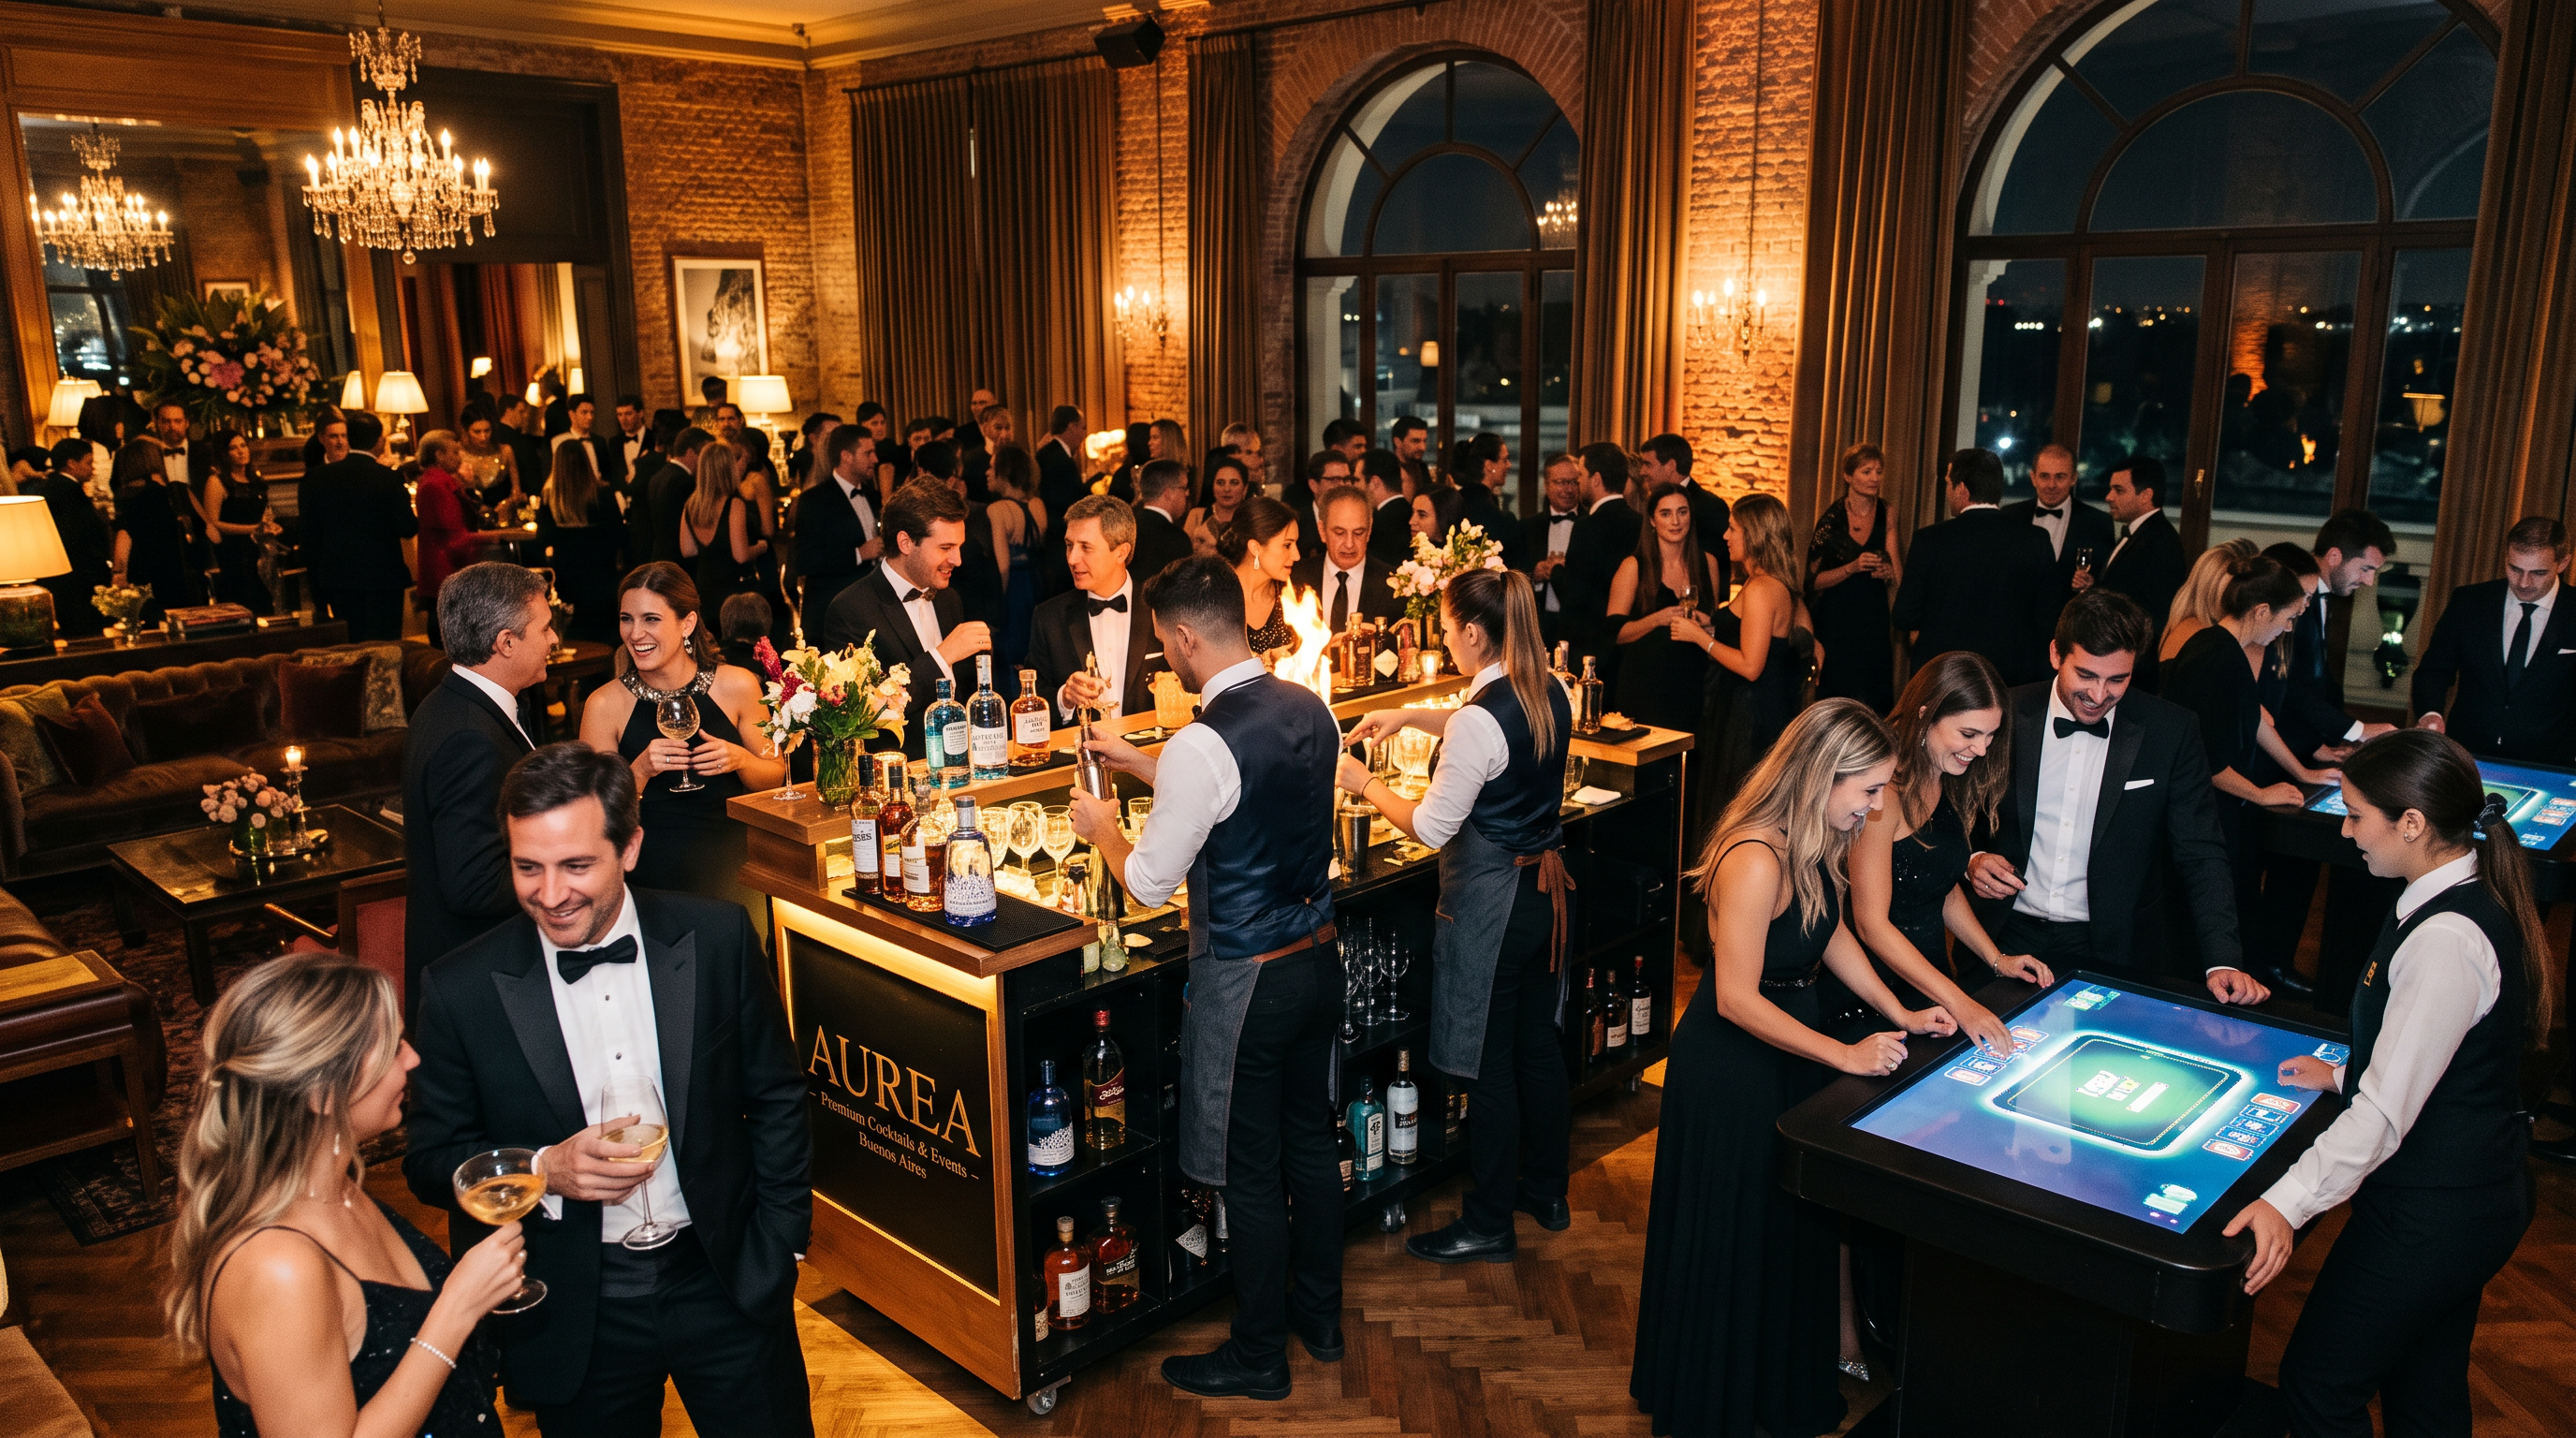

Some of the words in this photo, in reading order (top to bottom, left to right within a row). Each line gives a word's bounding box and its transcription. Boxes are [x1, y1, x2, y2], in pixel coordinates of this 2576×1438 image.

[808, 1025, 981, 1158] AUREA
[821, 1091, 866, 1126] Premium
[868, 1116, 915, 1151] Cocktails
[917, 1141, 928, 1158] &
[931, 1147, 968, 1178] Events
[858, 1131, 897, 1163] Buenos
[899, 1153, 927, 1179] Aires
